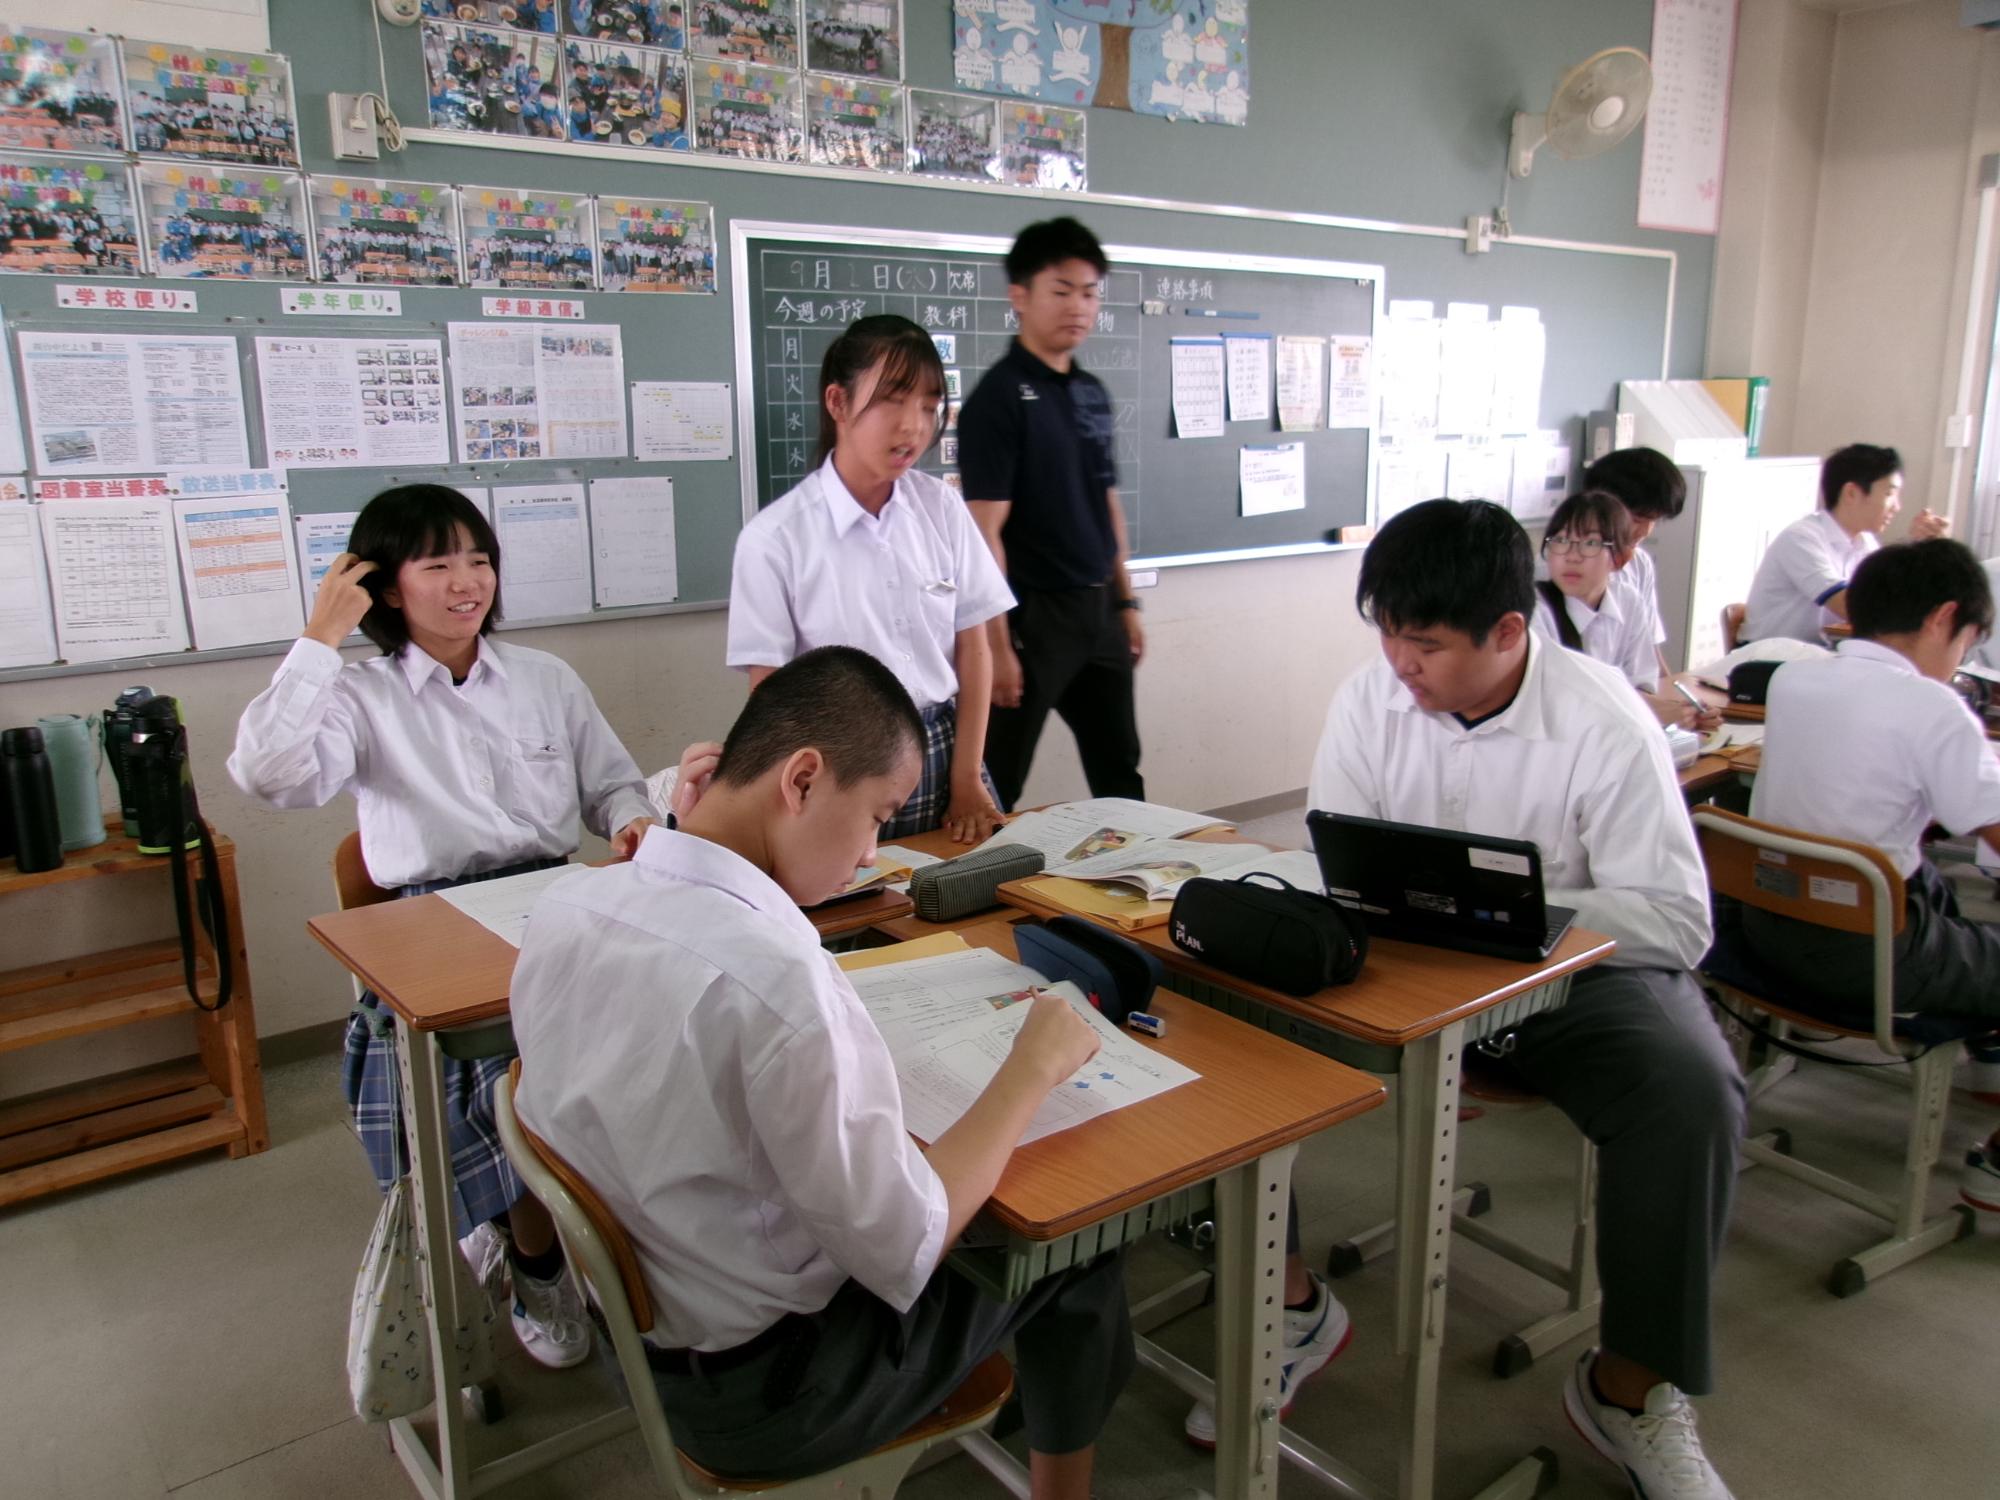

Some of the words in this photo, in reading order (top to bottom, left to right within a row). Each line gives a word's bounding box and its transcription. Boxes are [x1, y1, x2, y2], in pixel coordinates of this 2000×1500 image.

[949, 270, 976, 293] 欠席
[1156, 278, 1214, 301] 連絡事項
[75, 288, 177, 309] 学校便り
[297, 292, 384, 311] 学年便り
[496, 299, 572, 316] 学級通信
[775, 296, 867, 324] 今週の予定
[923, 305, 967, 329] 教科
[786, 337, 798, 360] 月
[787, 374, 802, 395] 火
[786, 411, 803, 431] 水
[788, 447, 804, 467] 木
[40, 478, 167, 499] 図書室当番表
[181, 472, 278, 494] 放送当番表
